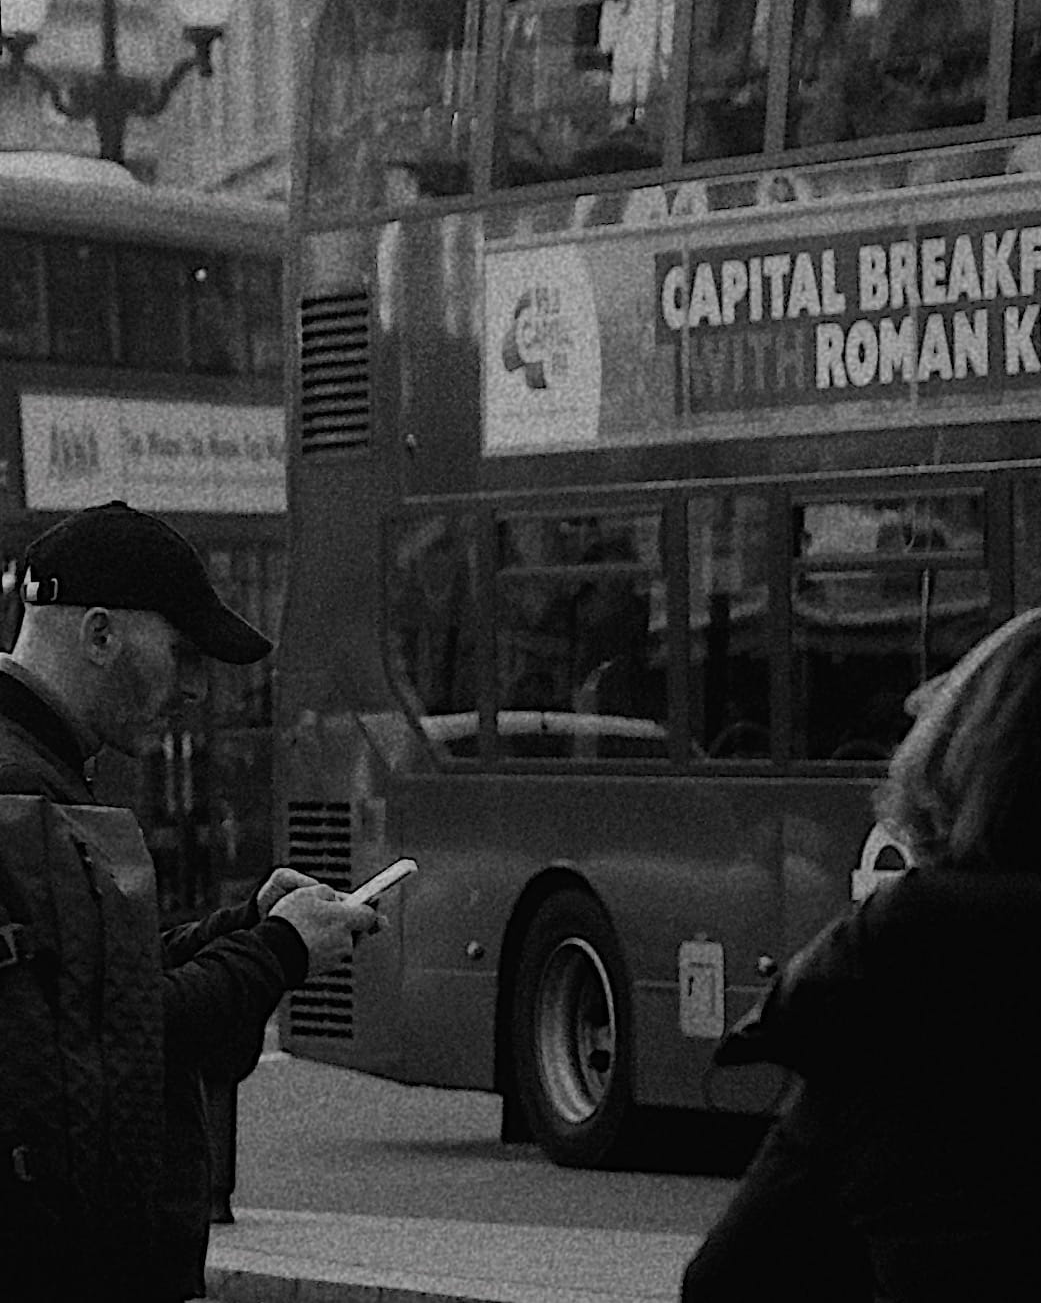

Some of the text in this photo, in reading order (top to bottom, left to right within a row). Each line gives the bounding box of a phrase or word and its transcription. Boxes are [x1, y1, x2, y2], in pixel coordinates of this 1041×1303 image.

[662, 249, 846, 330] CAPITAL
[690, 330, 805, 396] WITH
[816, 309, 989, 389] ROMAN
